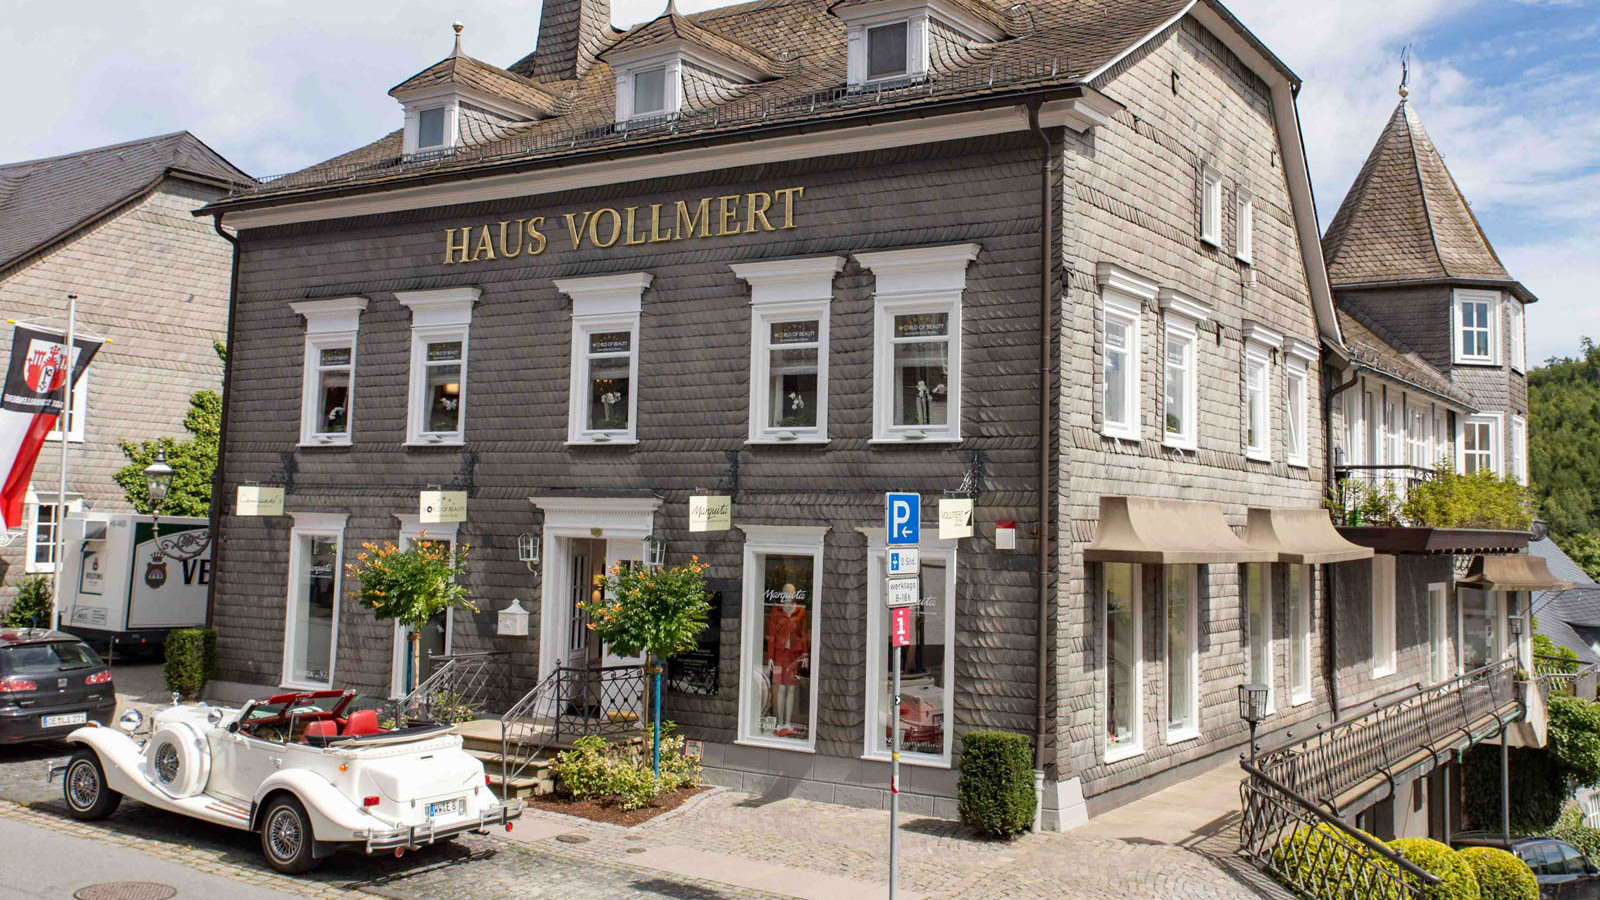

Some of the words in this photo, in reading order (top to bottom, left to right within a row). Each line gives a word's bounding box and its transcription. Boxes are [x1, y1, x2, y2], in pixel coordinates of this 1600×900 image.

[443, 216, 547, 266] HAUS
[562, 186, 806, 252] VOLLMERT
[893, 500, 910, 538] P
[890, 582, 917, 591] werktags
